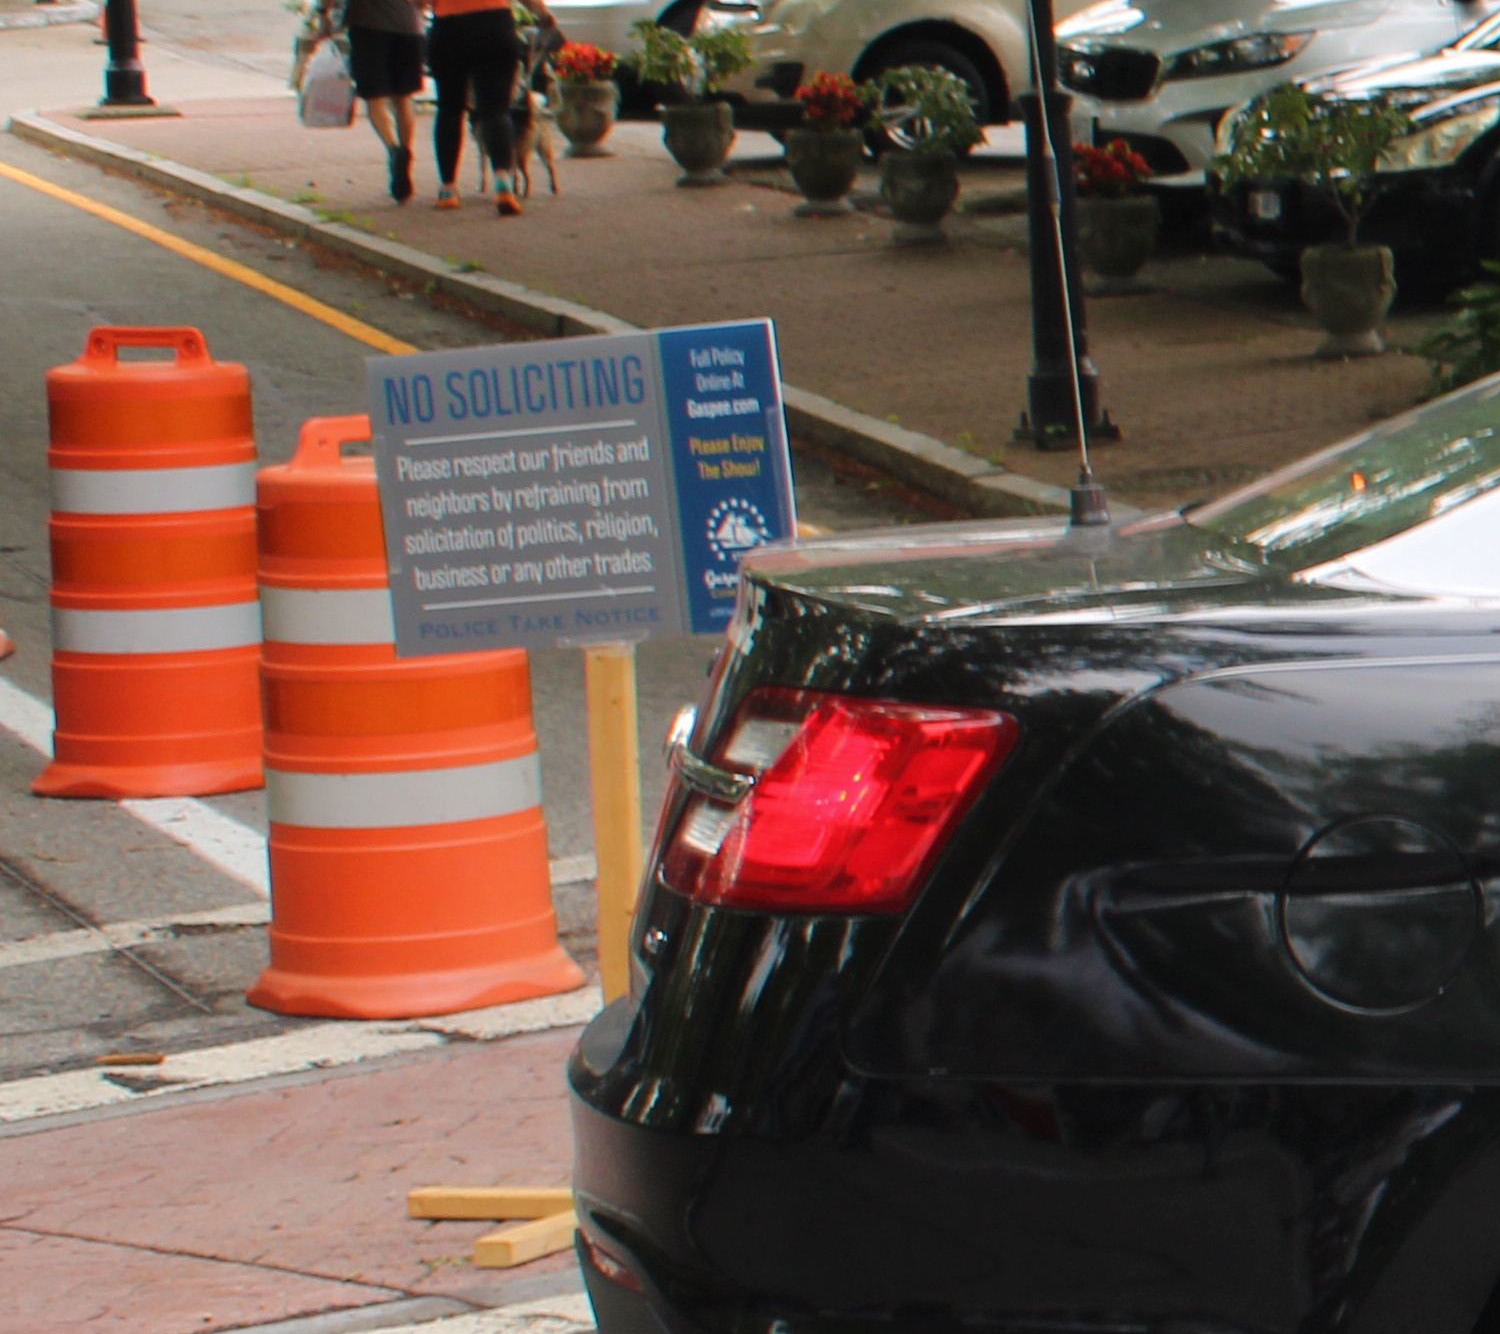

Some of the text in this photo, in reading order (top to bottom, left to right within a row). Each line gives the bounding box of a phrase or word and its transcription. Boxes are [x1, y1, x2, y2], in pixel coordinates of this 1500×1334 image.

[688, 348, 711, 368] Full
[384, 355, 645, 425] NO SOLICITING
[686, 399, 759, 418] Gaspee.com
[396, 435, 650, 482] Please respect our friends and
[689, 433, 765, 455] Please Enjoy
[697, 457, 760, 480] The Show!
[404, 476, 650, 521] neighbors by refraining from
[403, 509, 660, 556] solicitation of politics, religion,
[413, 563, 488, 592] business
[489, 564, 512, 585] or
[512, 561, 544, 586] any
[545, 553, 593, 581] other
